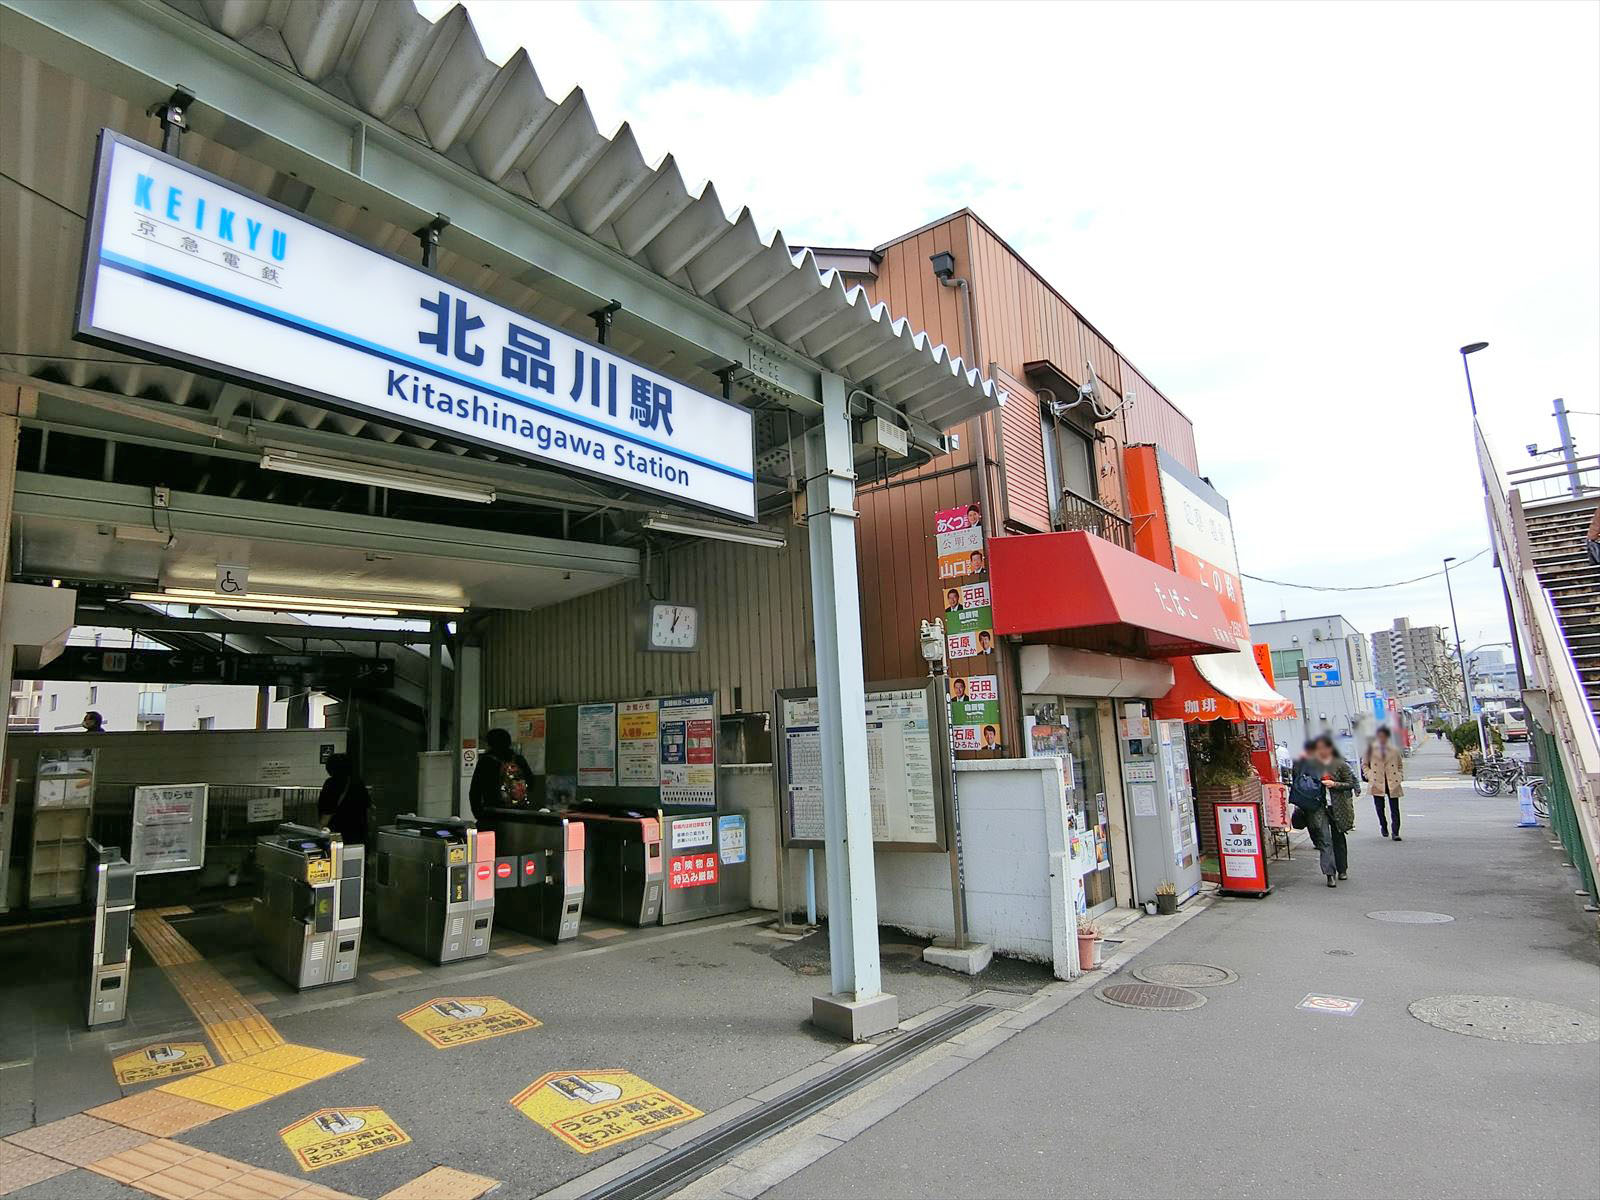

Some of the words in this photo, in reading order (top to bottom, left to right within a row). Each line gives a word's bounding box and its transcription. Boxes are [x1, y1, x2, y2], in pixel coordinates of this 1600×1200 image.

[134, 173, 286, 262] KEIKYU
[137, 219, 280, 284] 京急電鉄
[418, 290, 674, 437] 北品川駅
[386, 369, 605, 460] Kitashinagawa
[614, 444, 690, 486] Station
[936, 516, 964, 532] あくつ
[943, 534, 978, 550] 公明党
[940, 560, 966, 578] 山口
[963, 588, 984, 600] 石田
[1154, 582, 1198, 620] たばこ
[964, 598, 990, 608] ひでお
[949, 636, 970, 649] 石原
[950, 648, 976, 657] ひろたか
[970, 680, 992, 692] 石田
[1312, 672, 1327, 686] P
[954, 728, 975, 740] 石原
[673, 858, 714, 872] 危険物品
[673, 870, 714, 885] 持込み厳禁
